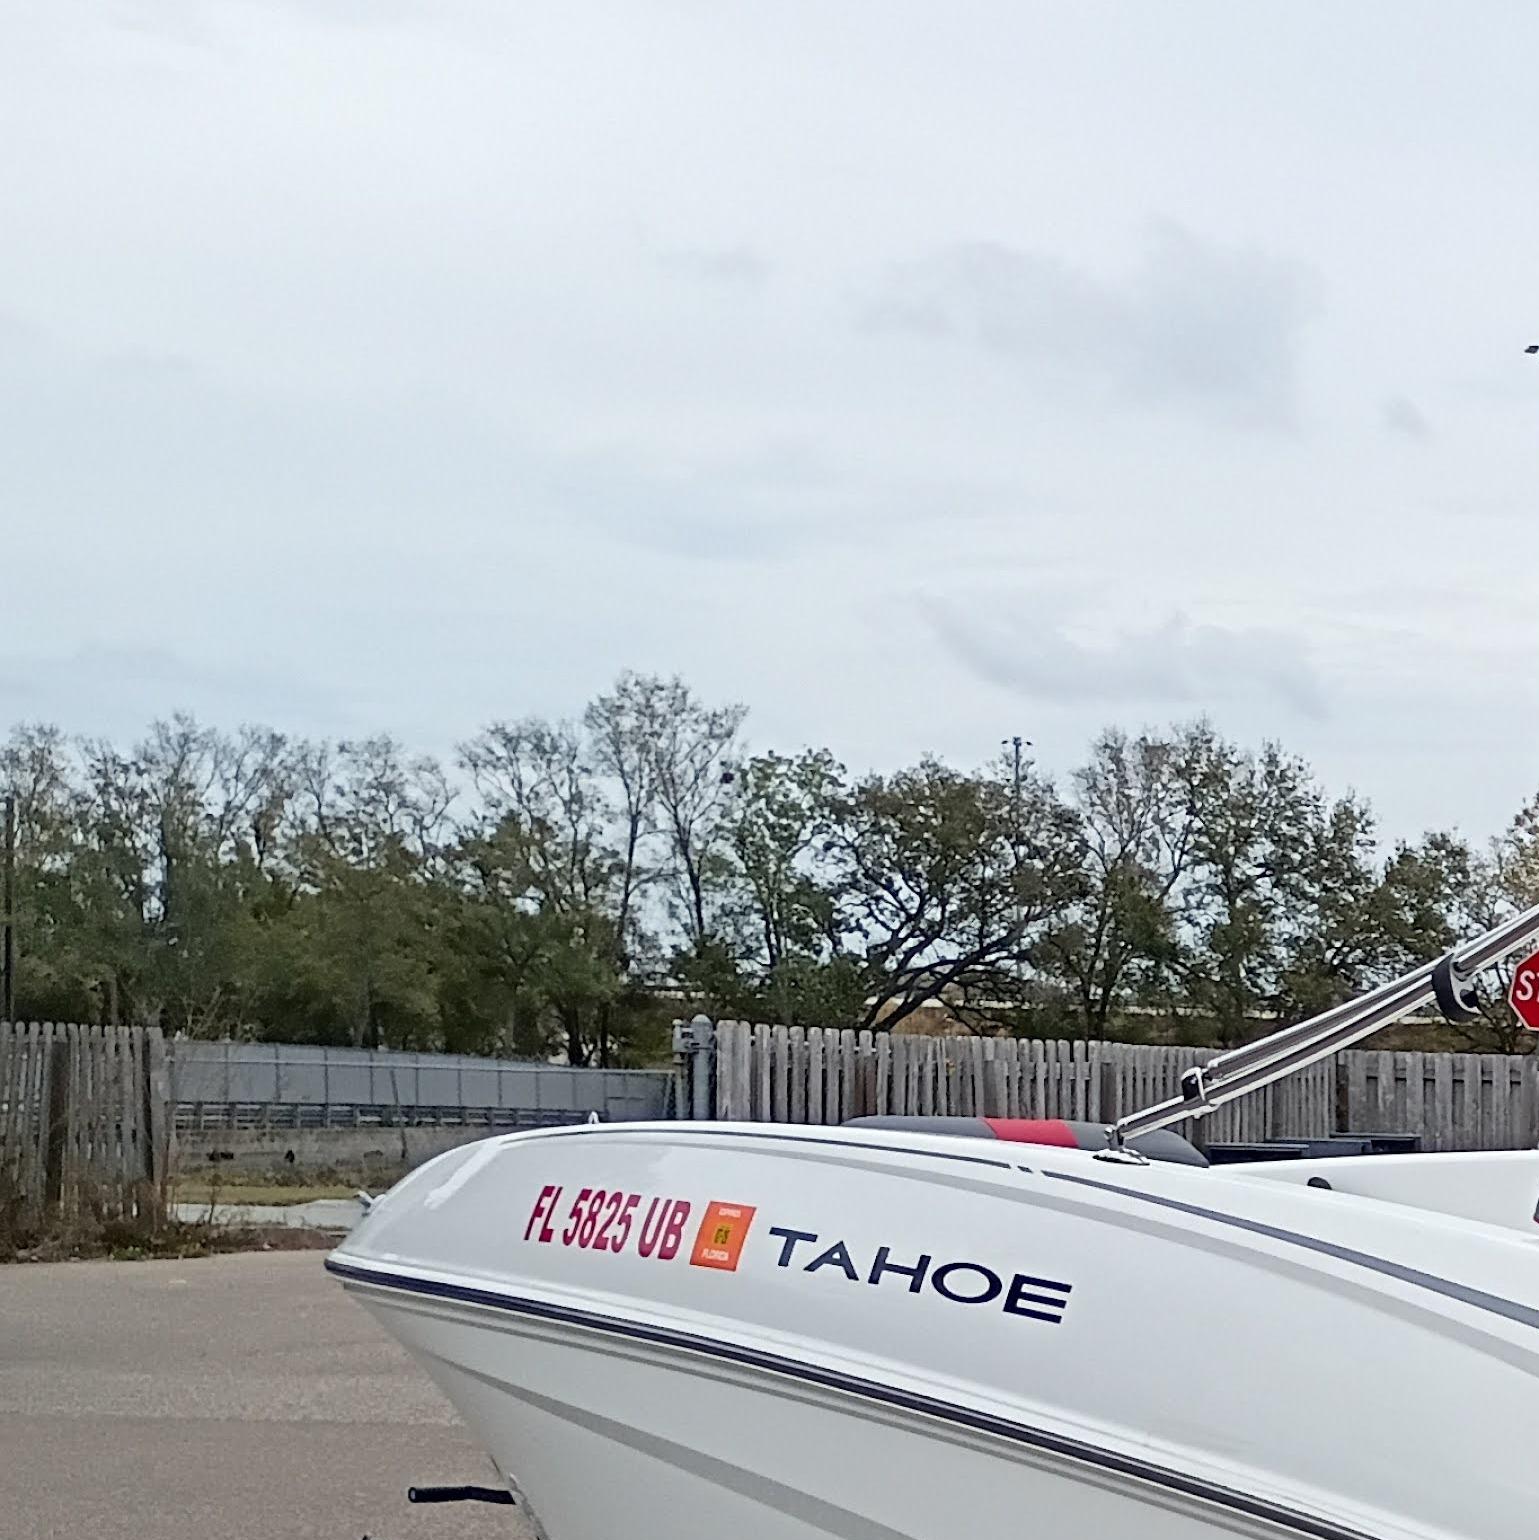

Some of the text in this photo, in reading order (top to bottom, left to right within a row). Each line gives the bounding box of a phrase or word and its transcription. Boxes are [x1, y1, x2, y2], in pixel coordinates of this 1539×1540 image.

[523, 1185, 691, 1260] FL 5825 UB
[769, 1226, 1073, 1324] TAHOE
